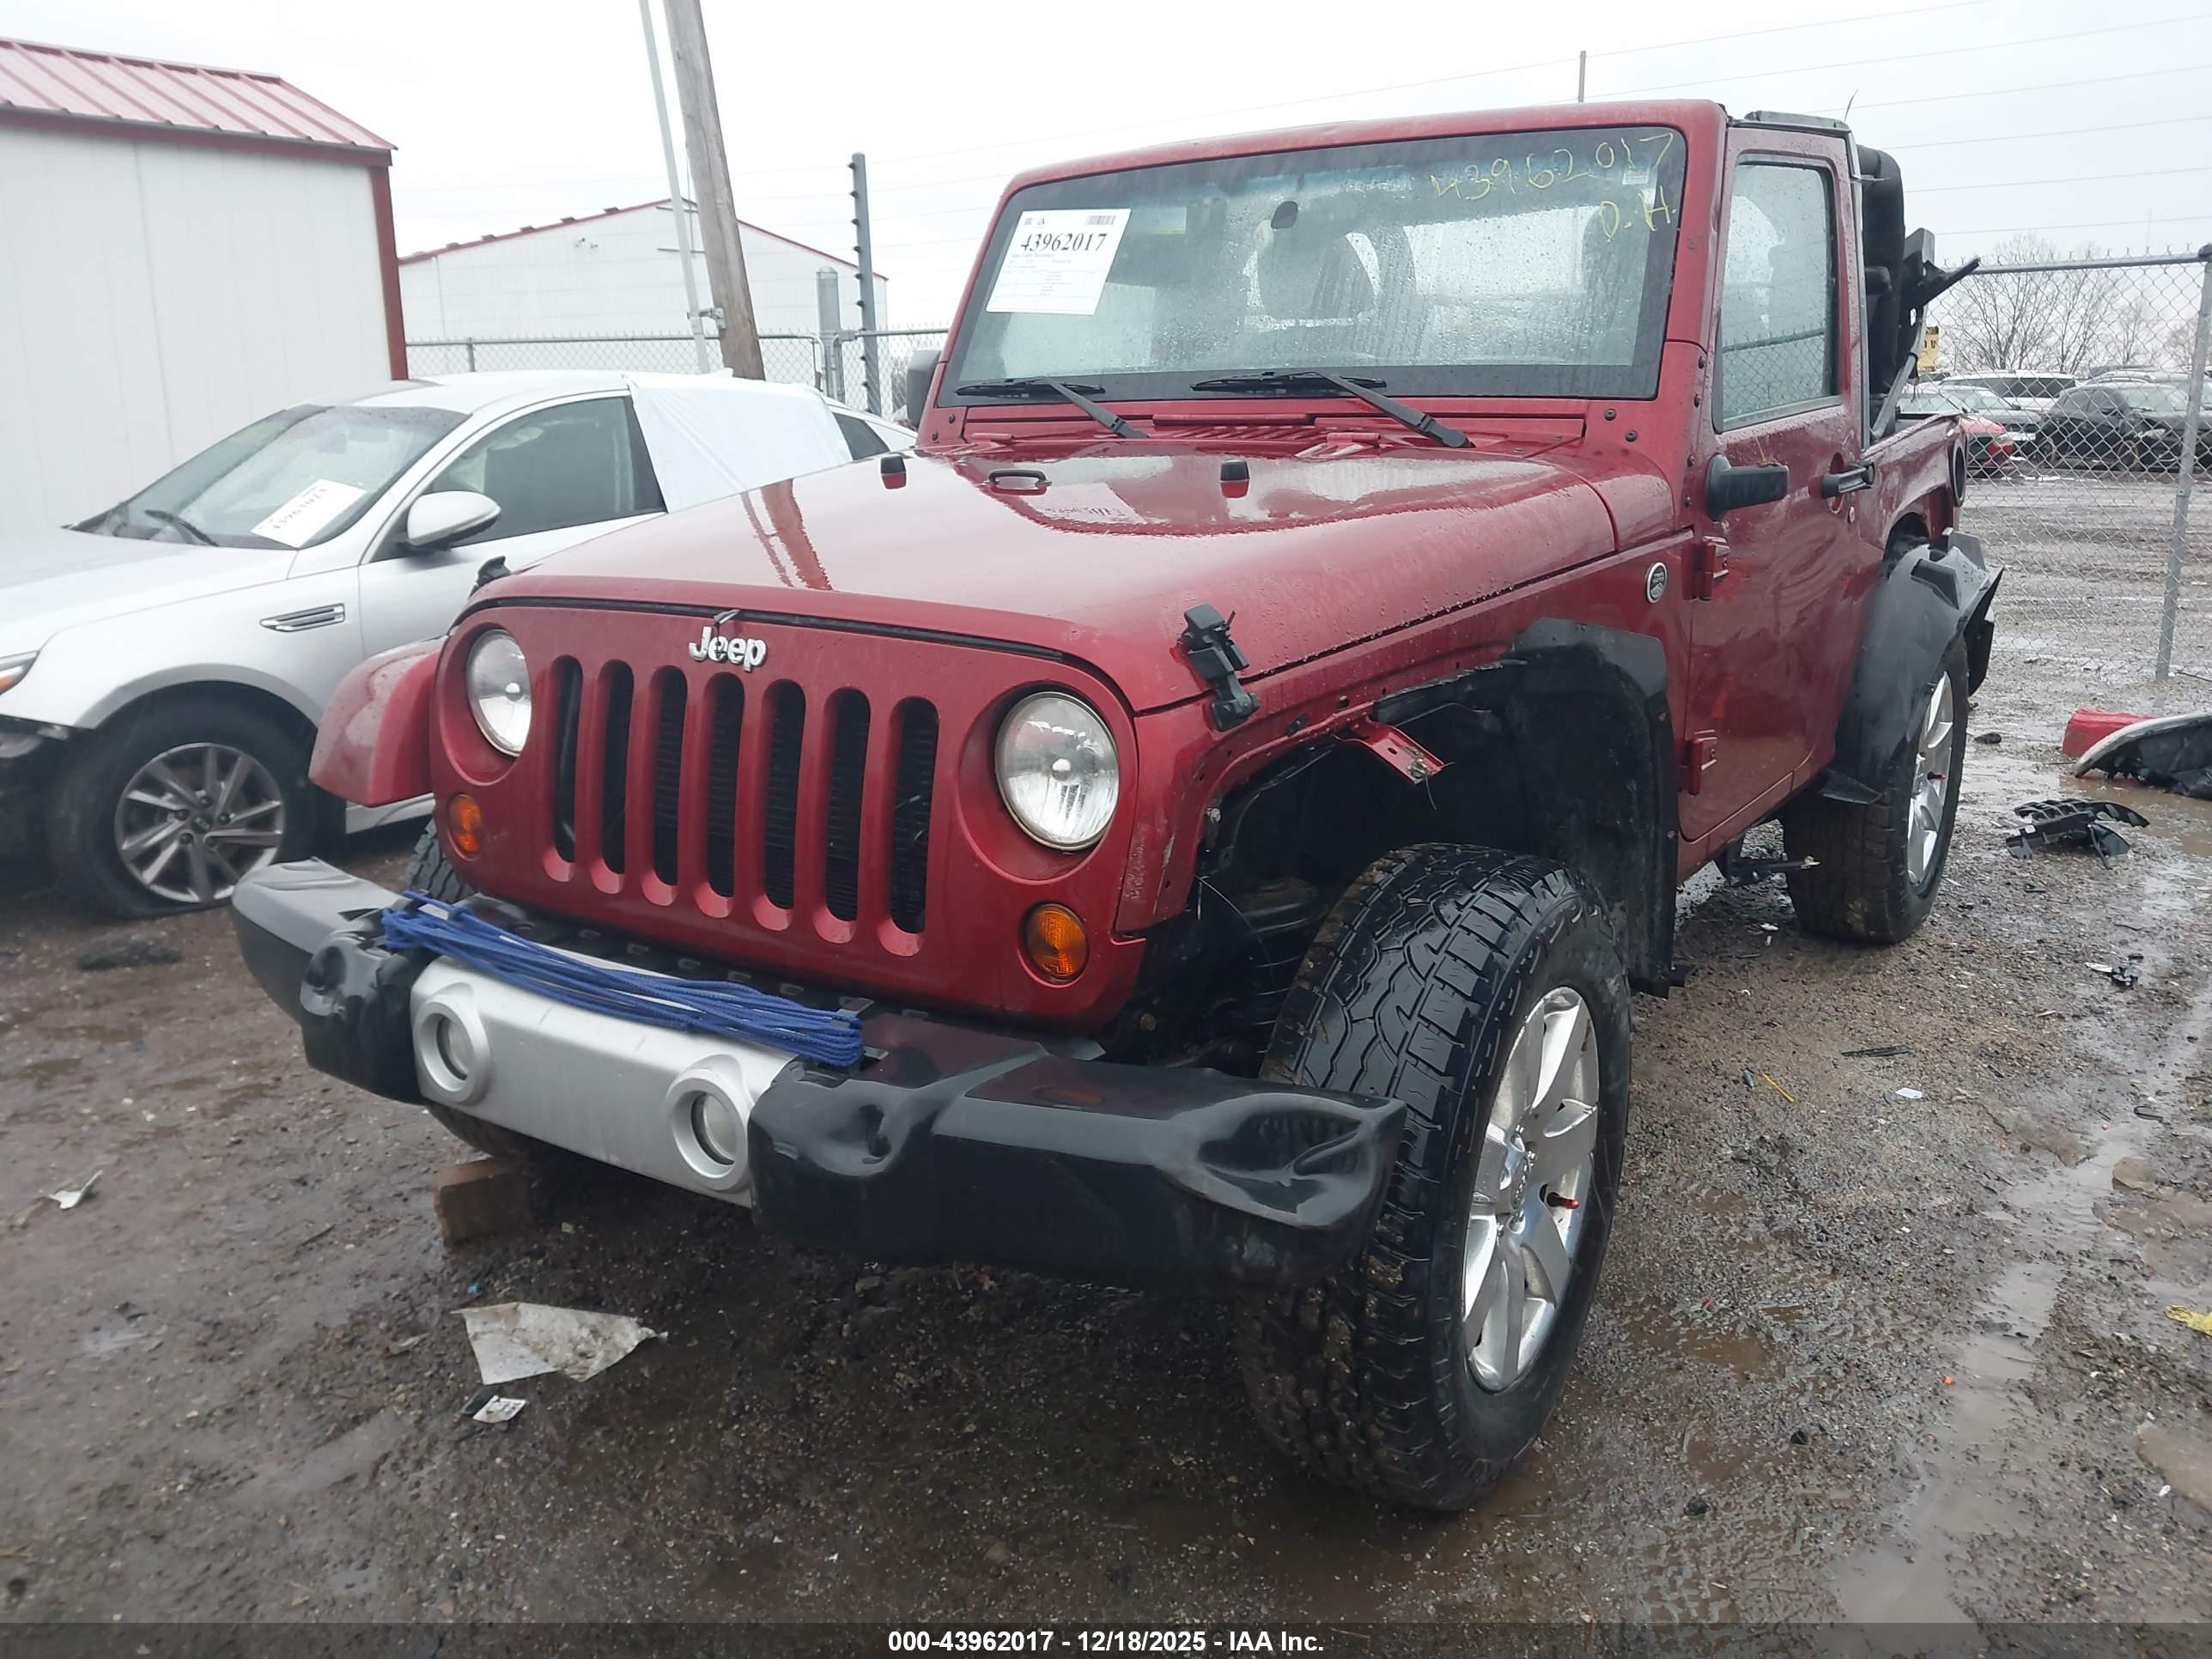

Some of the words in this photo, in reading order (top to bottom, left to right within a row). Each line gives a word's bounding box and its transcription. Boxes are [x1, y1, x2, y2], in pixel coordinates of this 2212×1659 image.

[1430, 131, 1674, 201] 43962017
[1020, 233, 1109, 252] 43962017
[688, 626, 768, 673] Jeep
